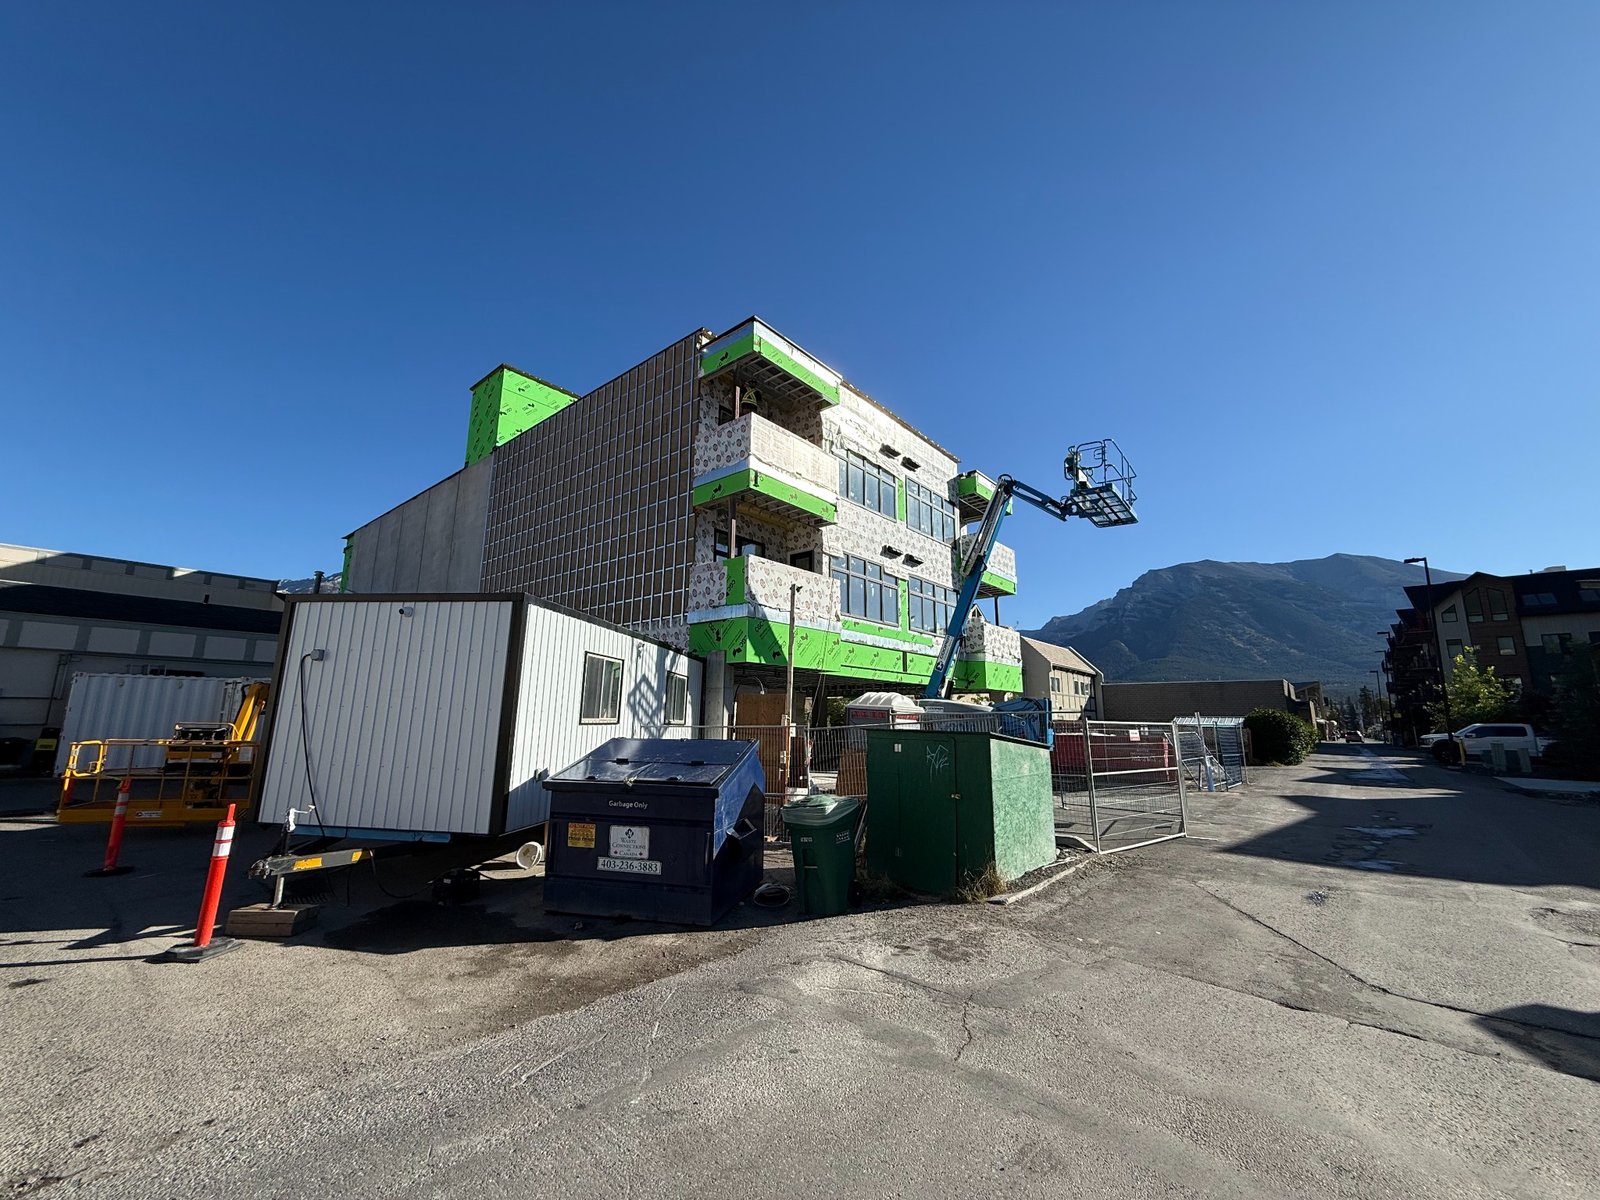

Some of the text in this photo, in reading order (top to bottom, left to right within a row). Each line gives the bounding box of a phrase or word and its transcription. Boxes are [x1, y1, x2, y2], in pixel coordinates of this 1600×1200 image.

[608, 800, 648, 810] Garbage Only
[601, 860, 658, 872] 403-236-3883
